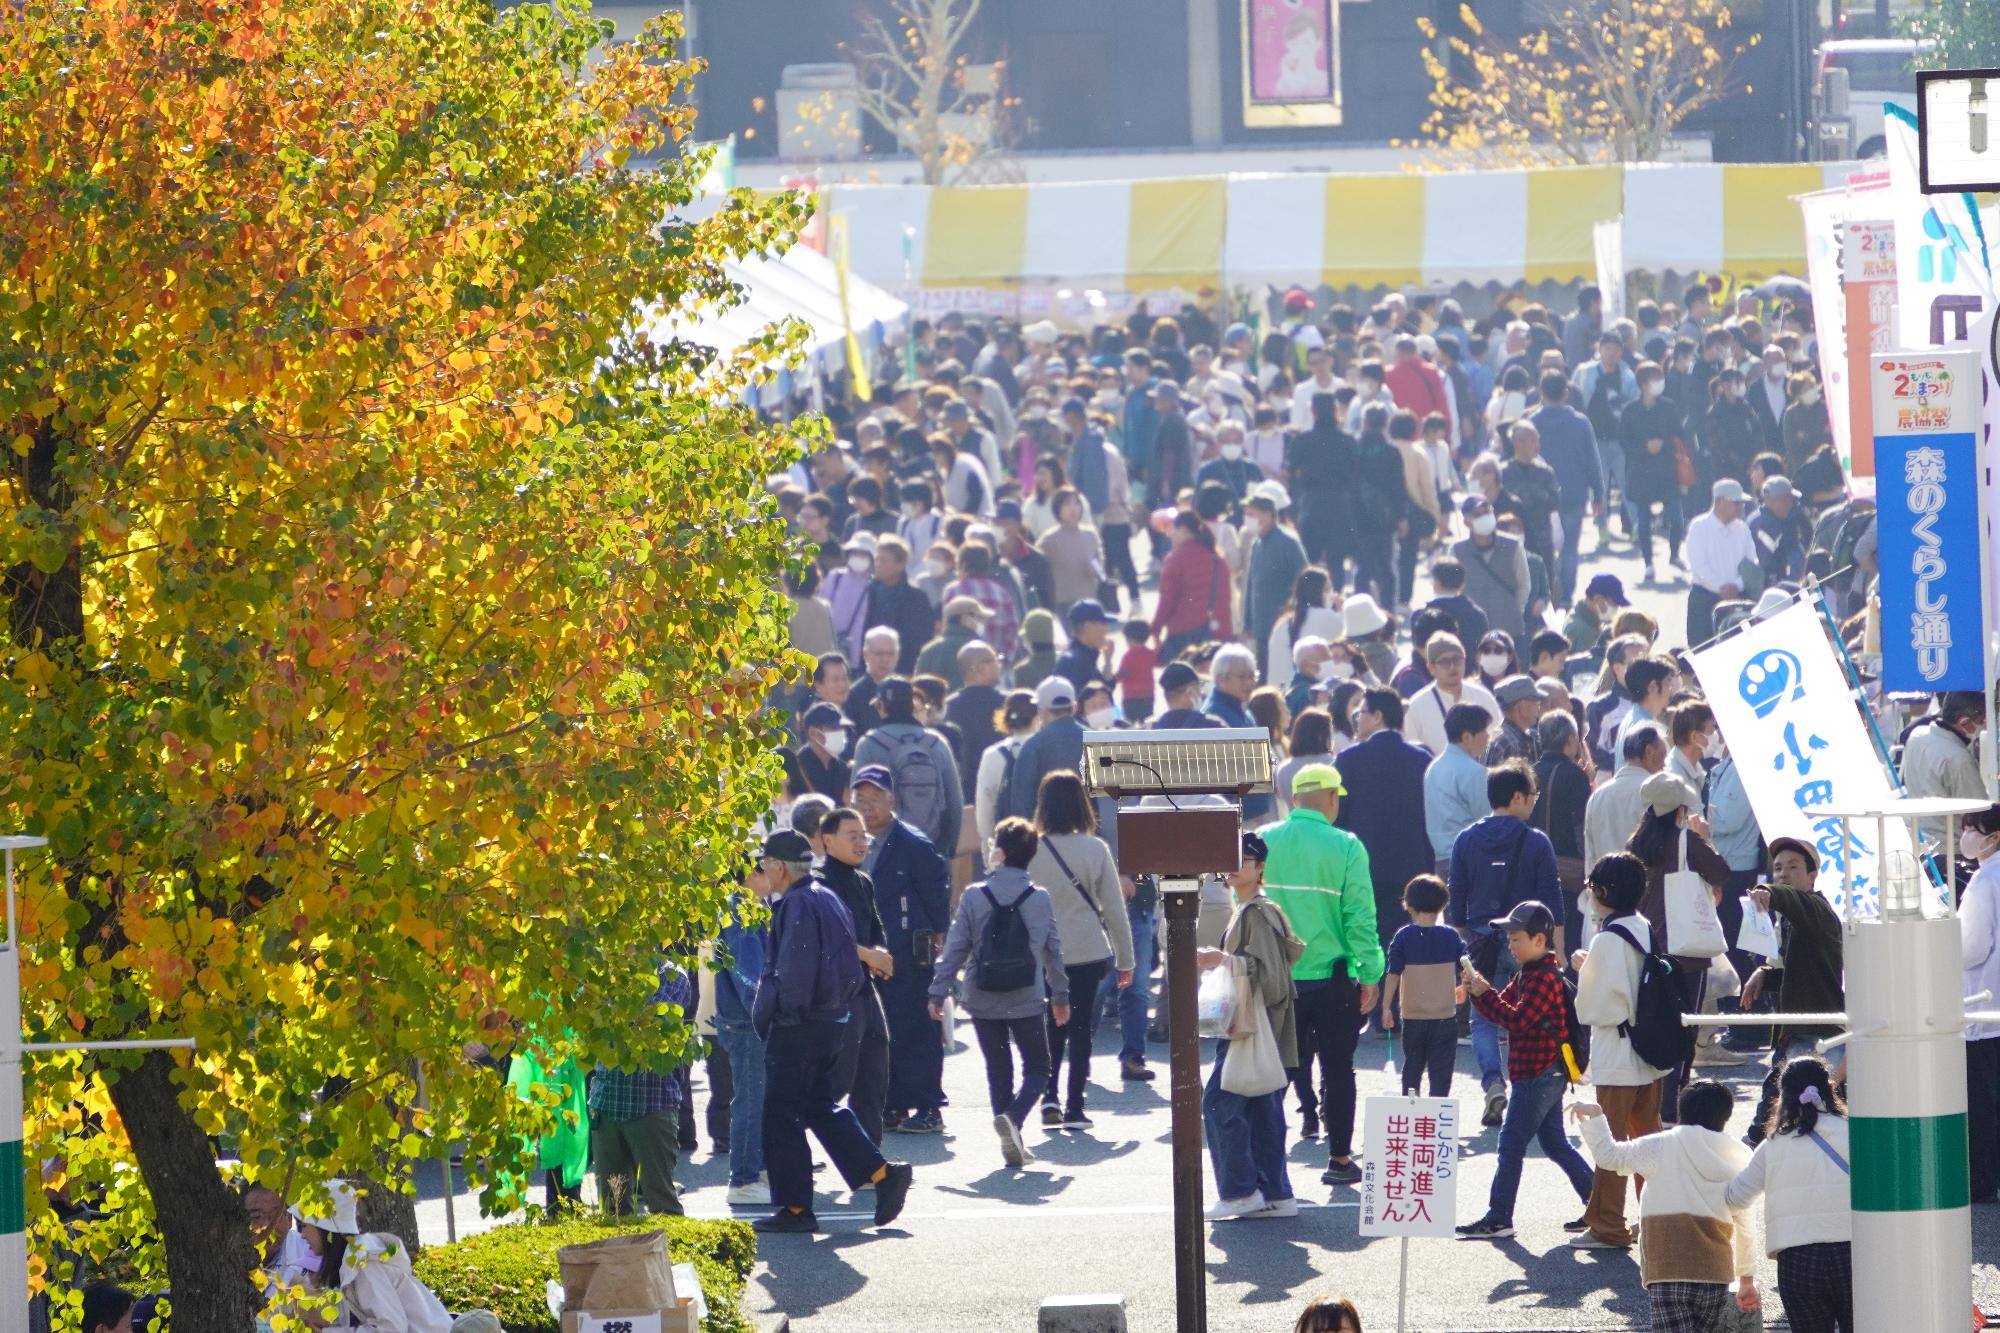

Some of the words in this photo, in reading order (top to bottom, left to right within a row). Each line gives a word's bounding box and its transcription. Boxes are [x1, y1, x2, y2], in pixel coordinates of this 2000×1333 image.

[1904, 446, 1953, 682] 森のくらし通り
[1364, 1161, 1375, 1225] 森町文化会館
[1381, 1114, 1409, 1223] 出来ません
[1409, 1115, 1437, 1223] 車両進入
[1436, 1104, 1454, 1179] ここから
